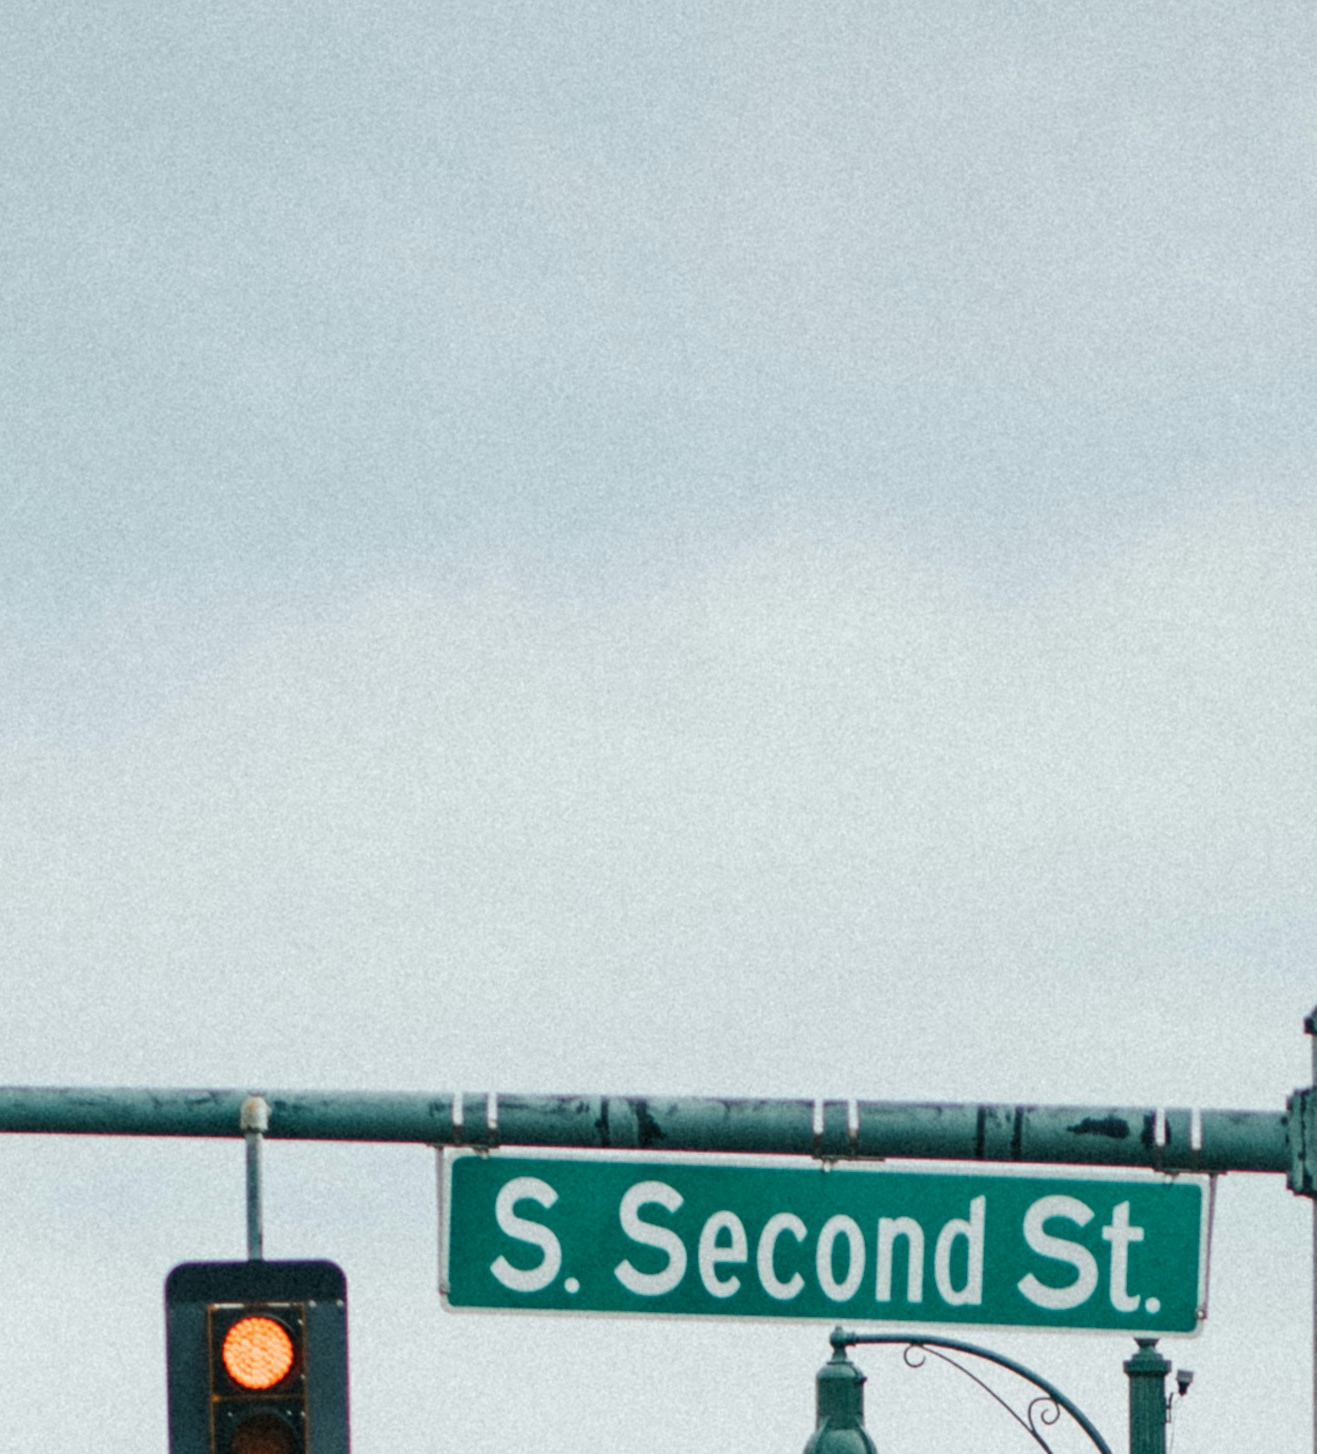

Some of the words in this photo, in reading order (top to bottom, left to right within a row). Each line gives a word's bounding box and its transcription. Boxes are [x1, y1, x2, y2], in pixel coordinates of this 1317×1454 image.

[490, 1175, 581, 1294] S.
[613, 1178, 987, 1307] Second
[1016, 1194, 1162, 1315] St.
